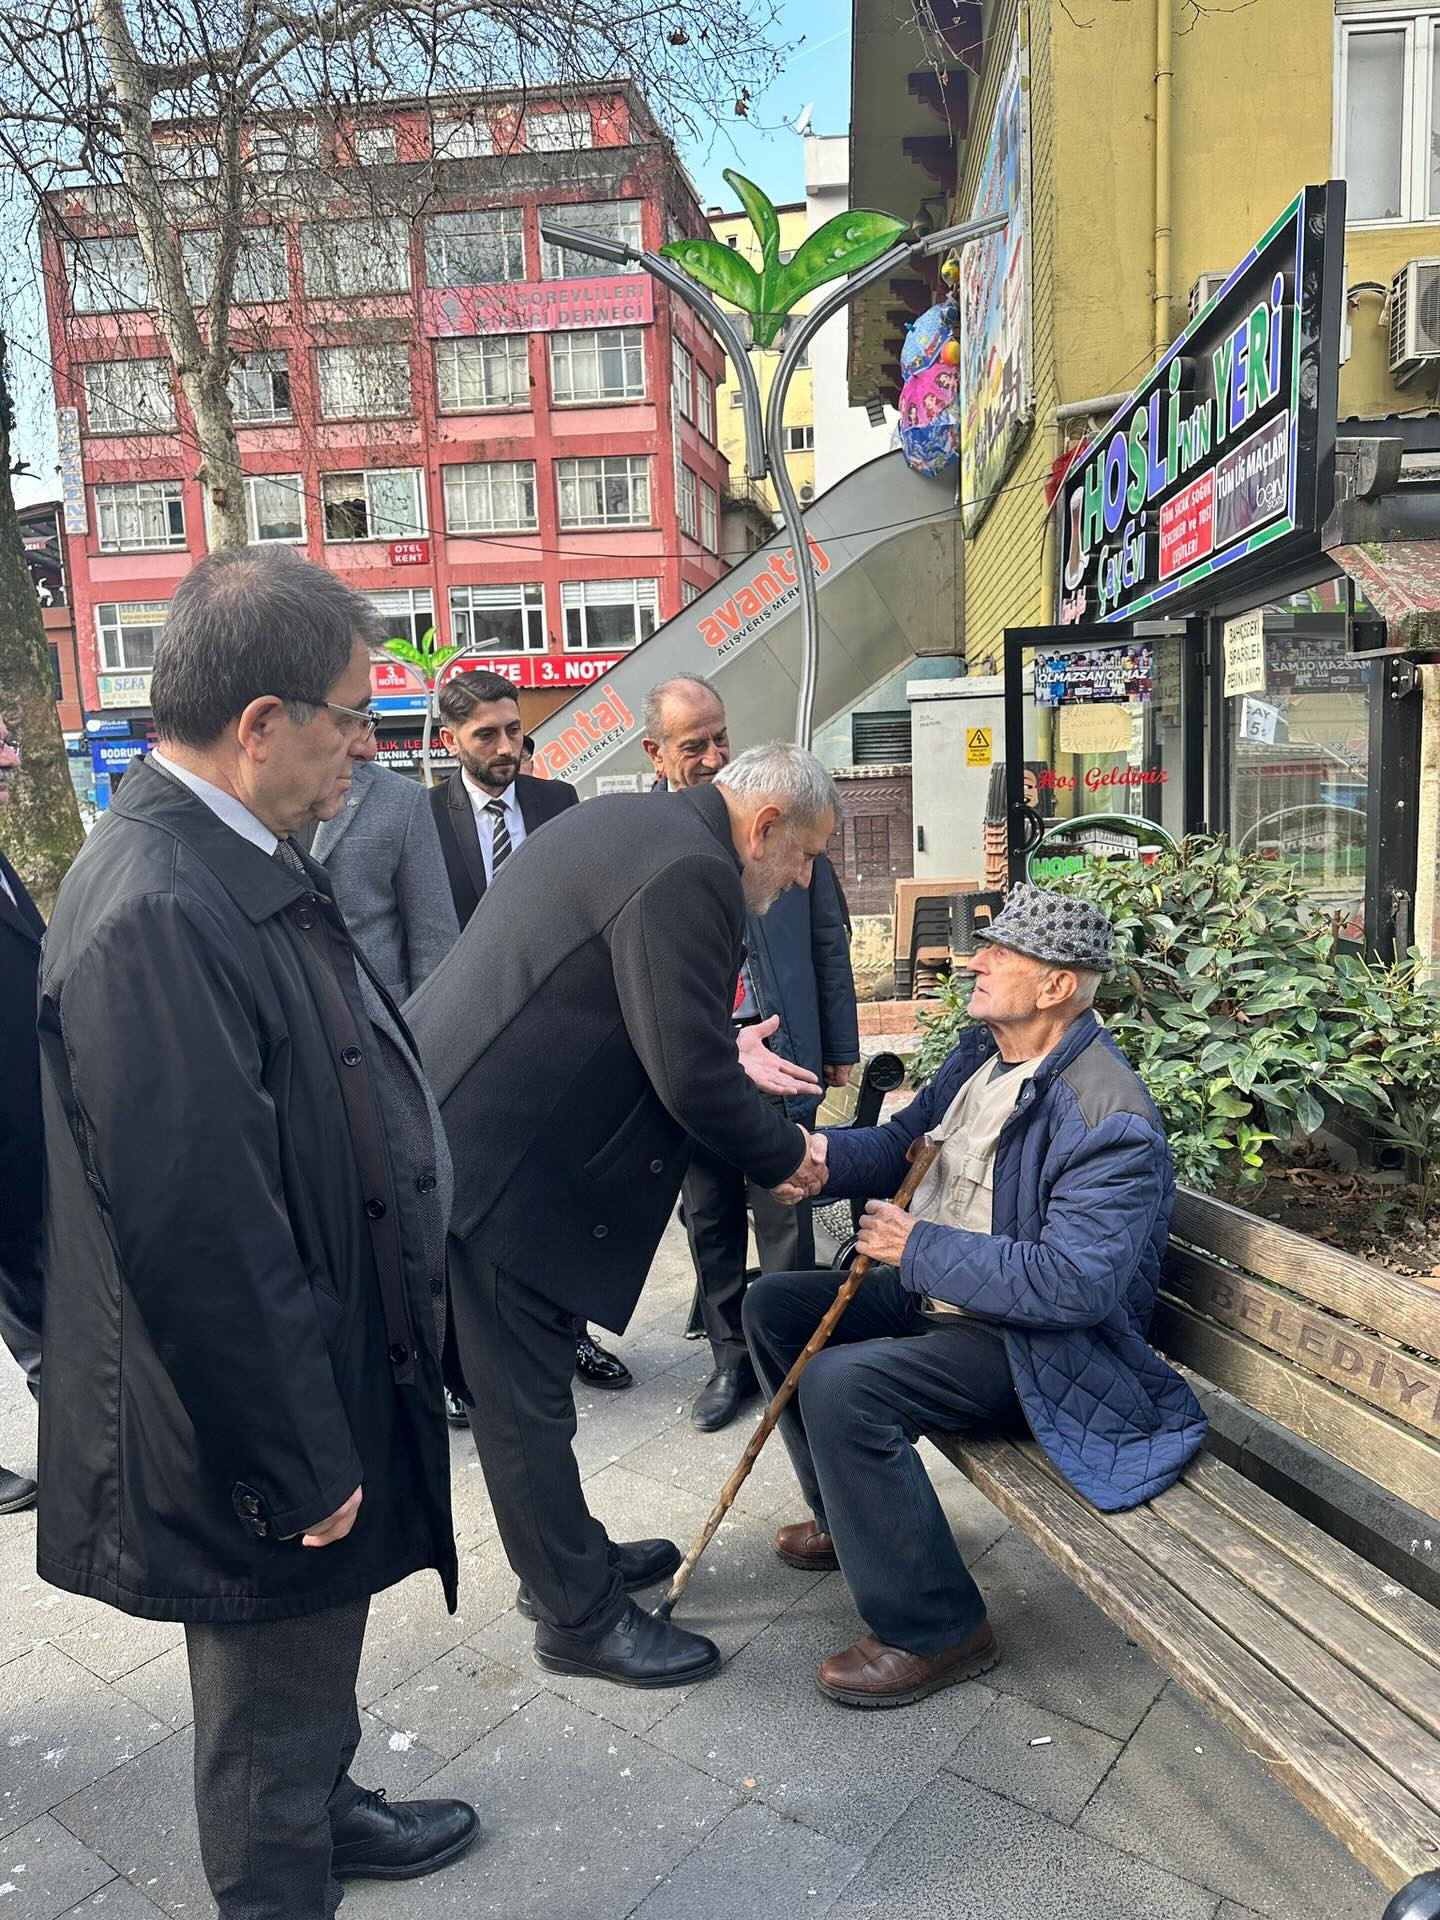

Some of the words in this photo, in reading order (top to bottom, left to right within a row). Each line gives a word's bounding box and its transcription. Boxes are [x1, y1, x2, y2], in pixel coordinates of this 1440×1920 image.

[1212, 271, 1284, 445] YERİ
[1217, 468, 1234, 499] TÜM
[1234, 456, 1246, 488] LİG
[1246, 429, 1287, 479] MAÇLARI
[1188, 517, 1197, 532] ve
[394, 544, 422, 553] OTEL
[395, 554, 423, 562] KENT
[697, 527, 831, 648] avantj
[386, 666, 397, 678] 3.
[541, 662, 560, 680] 3.
[1039, 671, 1104, 683] OLMAZSAN
[1106, 669, 1149, 680] OLMAZ
[115, 678, 146, 691] SEFA
[378, 677, 406, 686] NOTER
[533, 684, 635, 780] vantaj
[100, 748, 142, 759] BODRUM
[391, 759, 414, 767] USTA
[1038, 769, 1078, 791] Hoş
[1085, 763, 1169, 792] Geldiniz
[1207, 1278, 1440, 1422] BELEDİY
